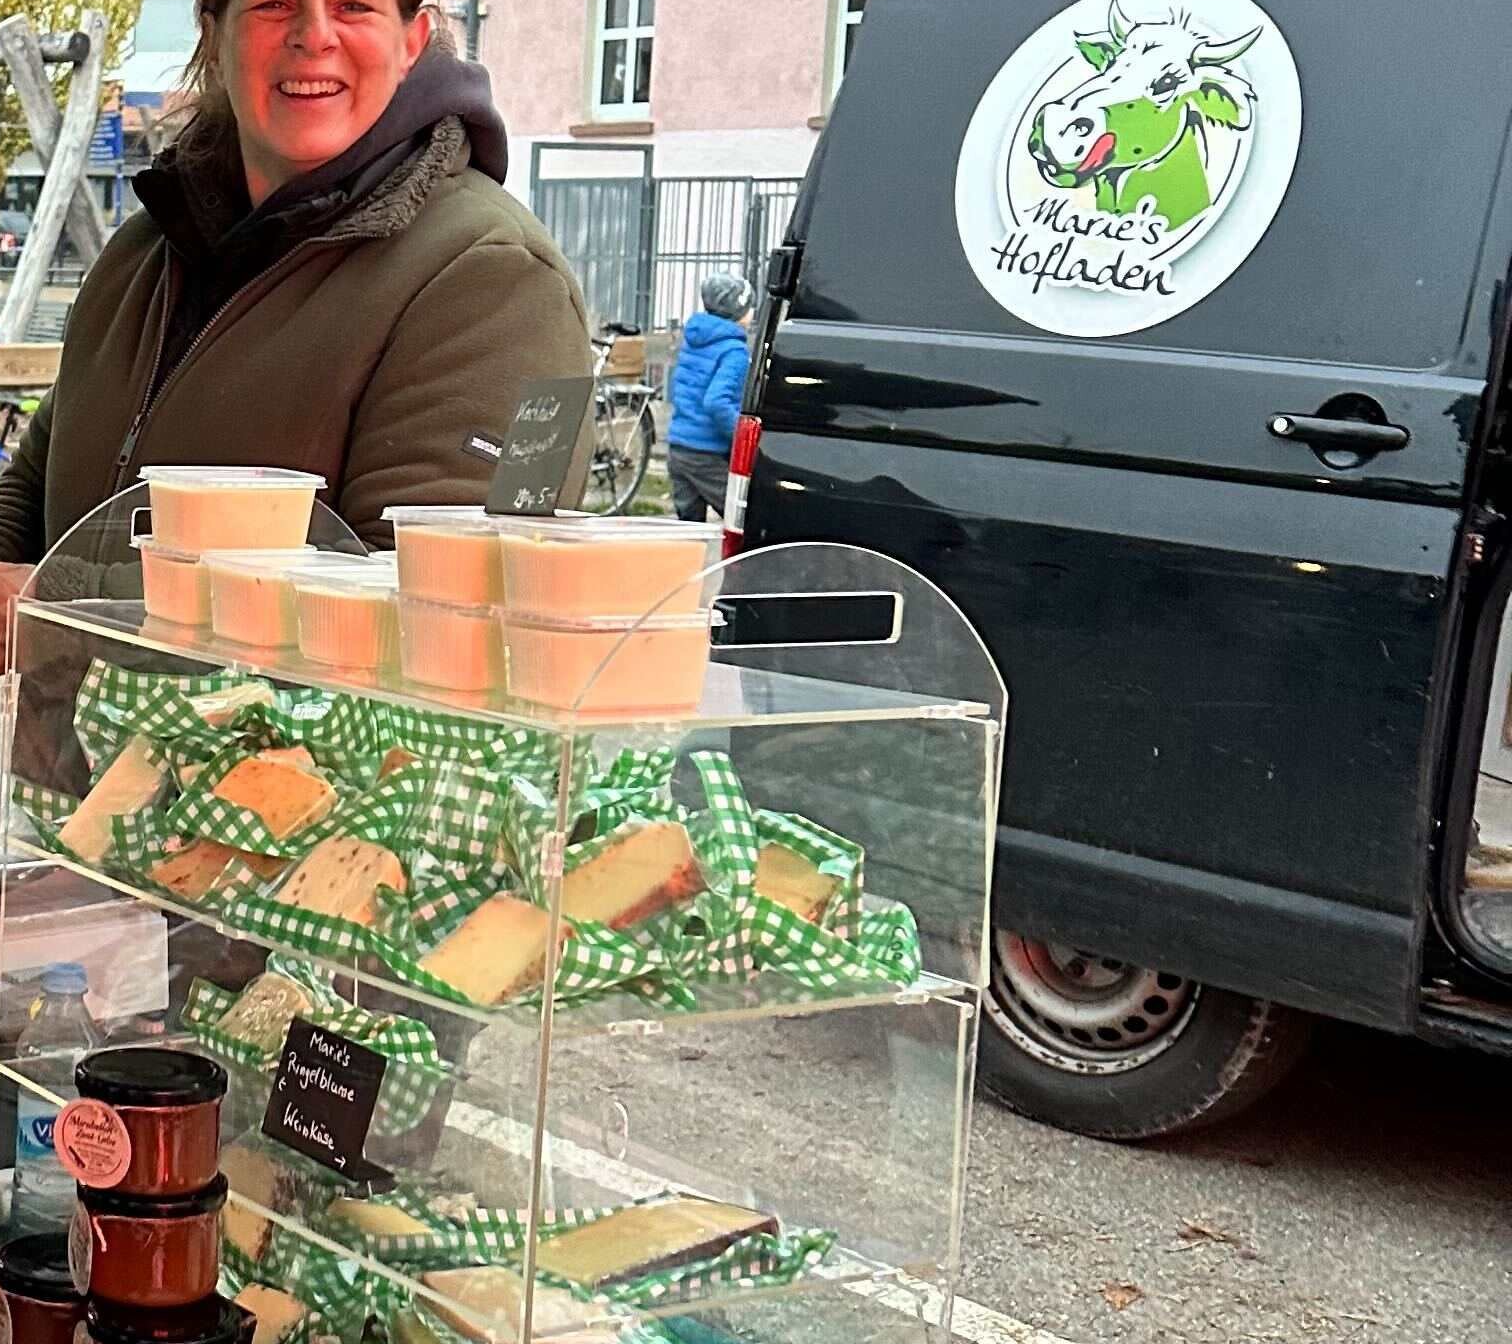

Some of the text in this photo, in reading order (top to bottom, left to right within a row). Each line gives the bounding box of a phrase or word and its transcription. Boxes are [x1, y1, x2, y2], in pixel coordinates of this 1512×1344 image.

[1022, 196, 1167, 245] Marie's
[990, 231, 1176, 296] Hofladen
[309, 1031, 351, 1068] Marie's
[287, 1051, 357, 1103] Ringelblume
